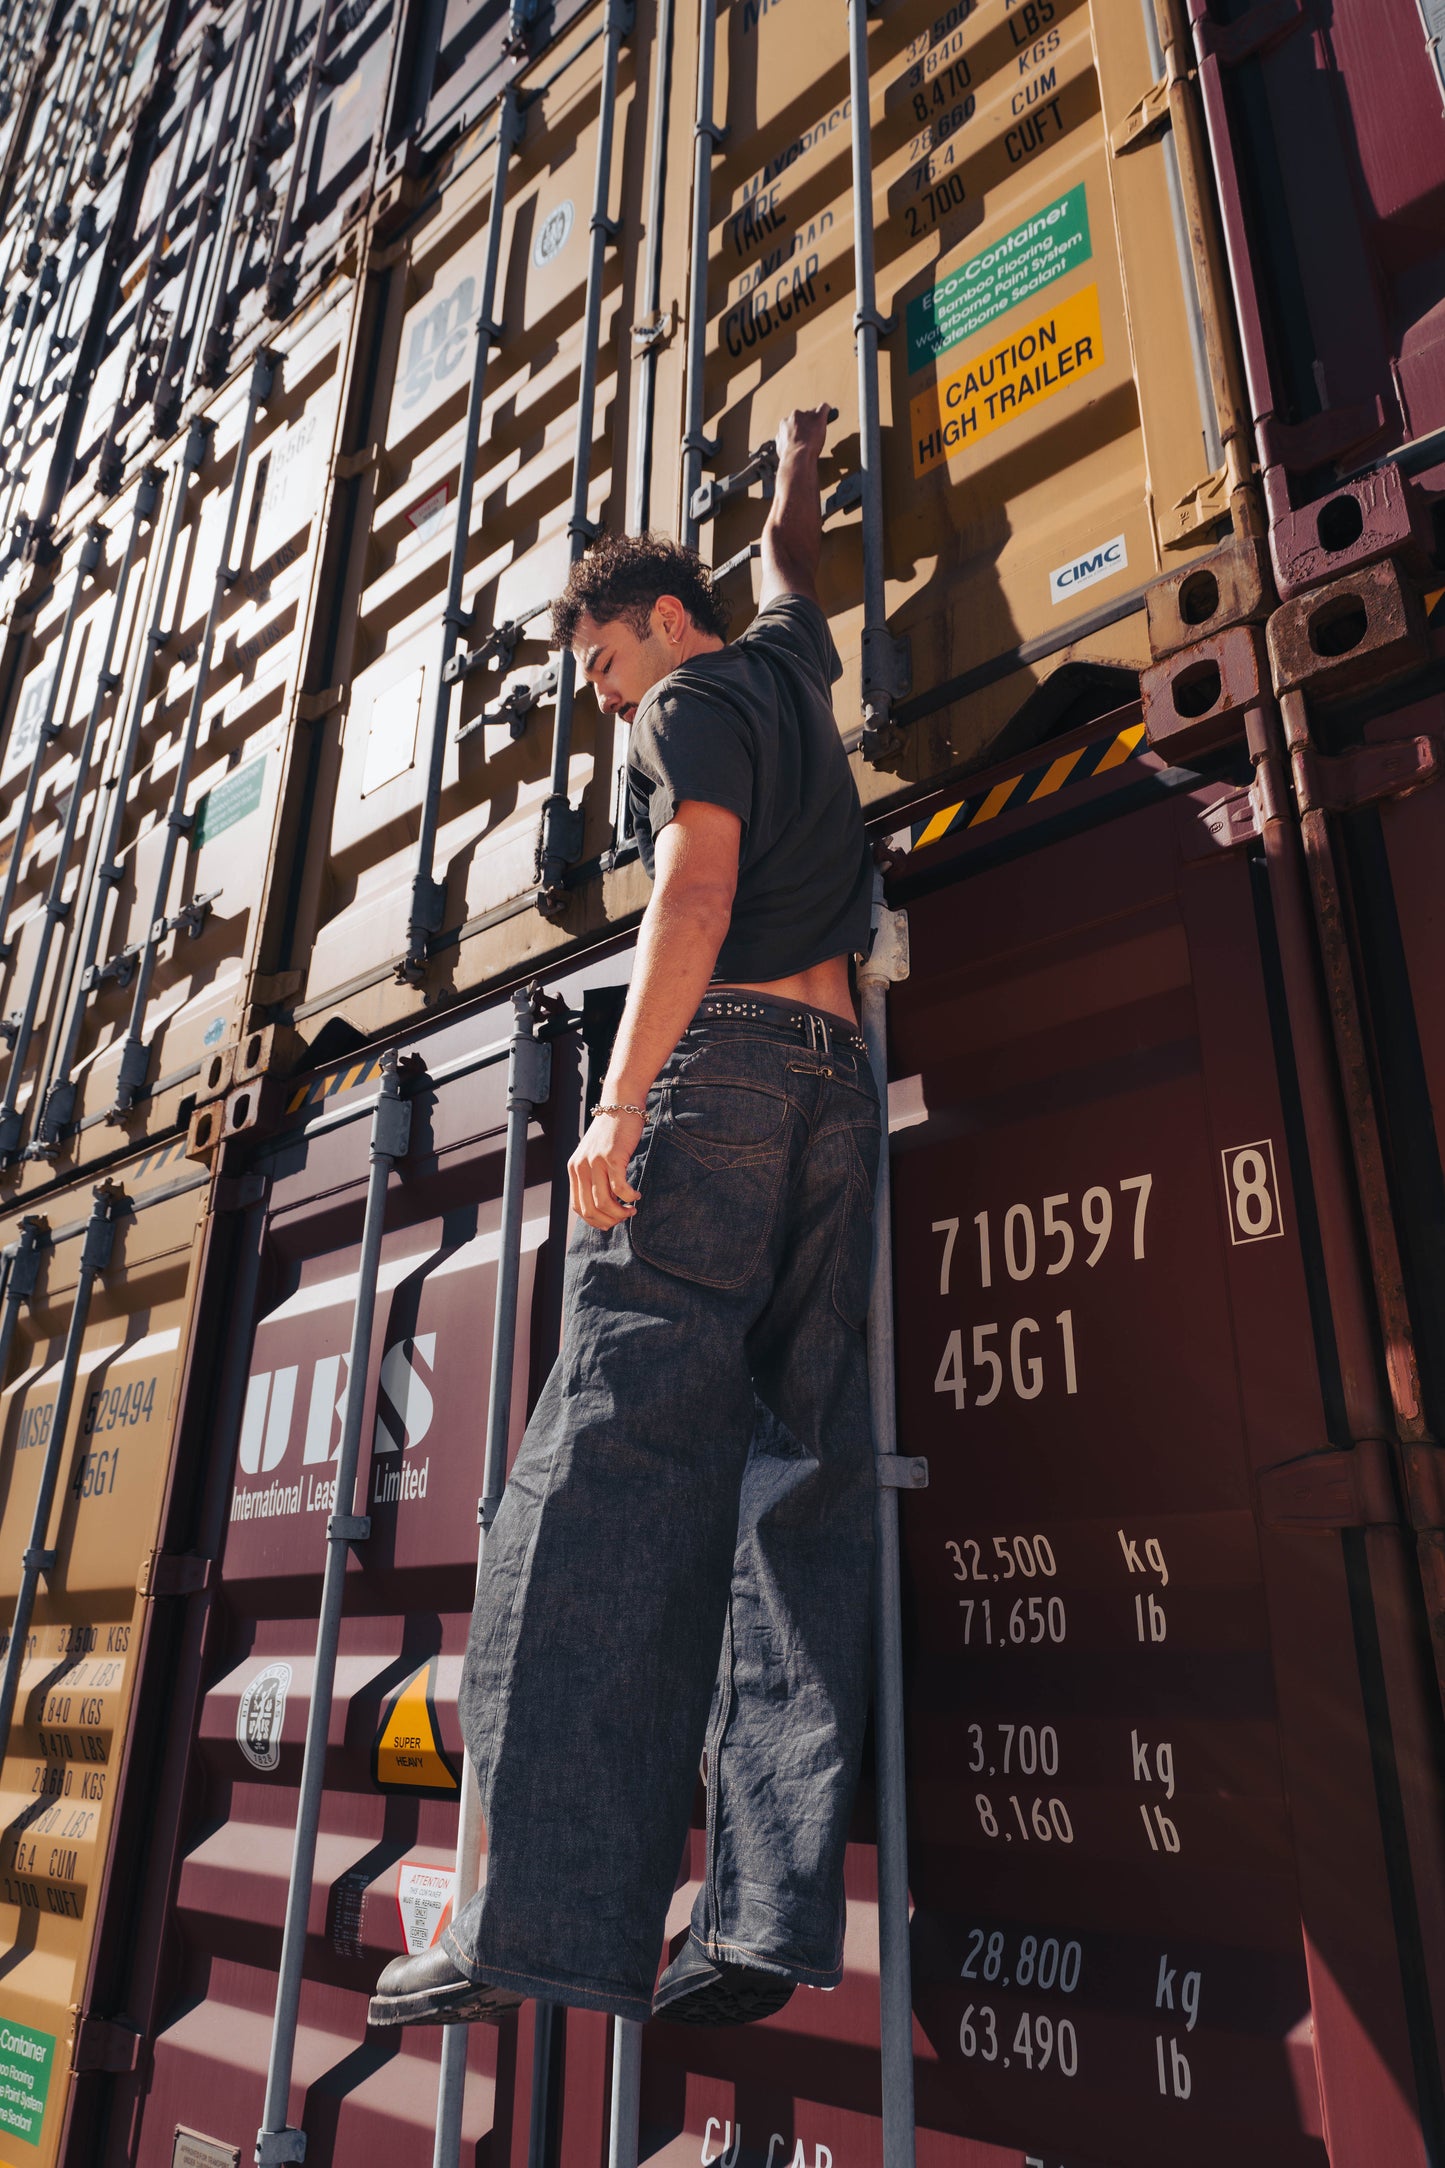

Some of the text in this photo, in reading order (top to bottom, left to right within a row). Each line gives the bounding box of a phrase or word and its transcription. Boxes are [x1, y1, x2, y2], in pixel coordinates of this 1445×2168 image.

[1009, 0, 1055, 47] LBS
[1019, 29, 1061, 75] KGS
[911, 144, 955, 191] 76.4
[1011, 66, 1057, 116] CUM
[1005, 97, 1064, 163] CUFT
[731, 183, 786, 257] TARE
[922, 200, 1069, 312] Eco-Container
[938, 235, 1054, 320] Bamboo Flooring
[915, 232, 1083, 349] Waterborne Paint System
[930, 257, 1067, 354] Waterborne Sealant
[945, 320, 1056, 408] CAUTION
[918, 336, 1093, 465] HIGH TRAILER
[1056, 544, 1121, 588] CIMC
[931, 1149, 1273, 1296] 710597 8
[934, 1309, 1078, 1410] 45G1
[16, 1377, 157, 1450] MSB 529494
[73, 1447, 120, 1500] 45G1
[230, 1457, 430, 1522] International Leas Limited
[945, 1529, 1169, 1587] 32,500 kg
[106, 1626, 131, 1652] KGS
[959, 1593, 1167, 1648] 71,650 lb
[89, 1663, 121, 1687] LBS
[37, 1696, 104, 1726] 3.840 KGS
[80, 1735, 106, 1762] LBS
[393, 1736, 421, 1749] SUPER
[396, 1756, 423, 1768] HEAVY
[967, 1723, 1175, 1800] 3,700 kg
[32, 1766, 106, 1801] 28.660 KGS
[61, 1810, 94, 1839] LBS
[975, 1793, 1181, 1853] 8,160 lb
[10, 1841, 78, 1881] 76.4 CUM
[409, 1874, 451, 1889] ATTENTION
[46, 1887, 79, 1919] CUFT
[403, 1896, 414, 1904] MUST
[422, 1899, 442, 1910] REPAIRED
[416, 1908, 426, 1917] ONLY
[419, 1888, 442, 1898] CONTAINER
[411, 1928, 428, 1938] CORTEN
[412, 1938, 424, 1949] STEEL
[415, 1919, 425, 1927] WITH
[960, 1929, 1201, 2032] 28,800 kg
[959, 2003, 1192, 2100] 63,490 lb
[5, 2085, 21, 2101] Paint
[21, 2087, 43, 2114] System
[9, 2065, 35, 2090] Flooring
[8, 2109, 32, 2132] Sealant
[700, 2117, 741, 2168] CU
